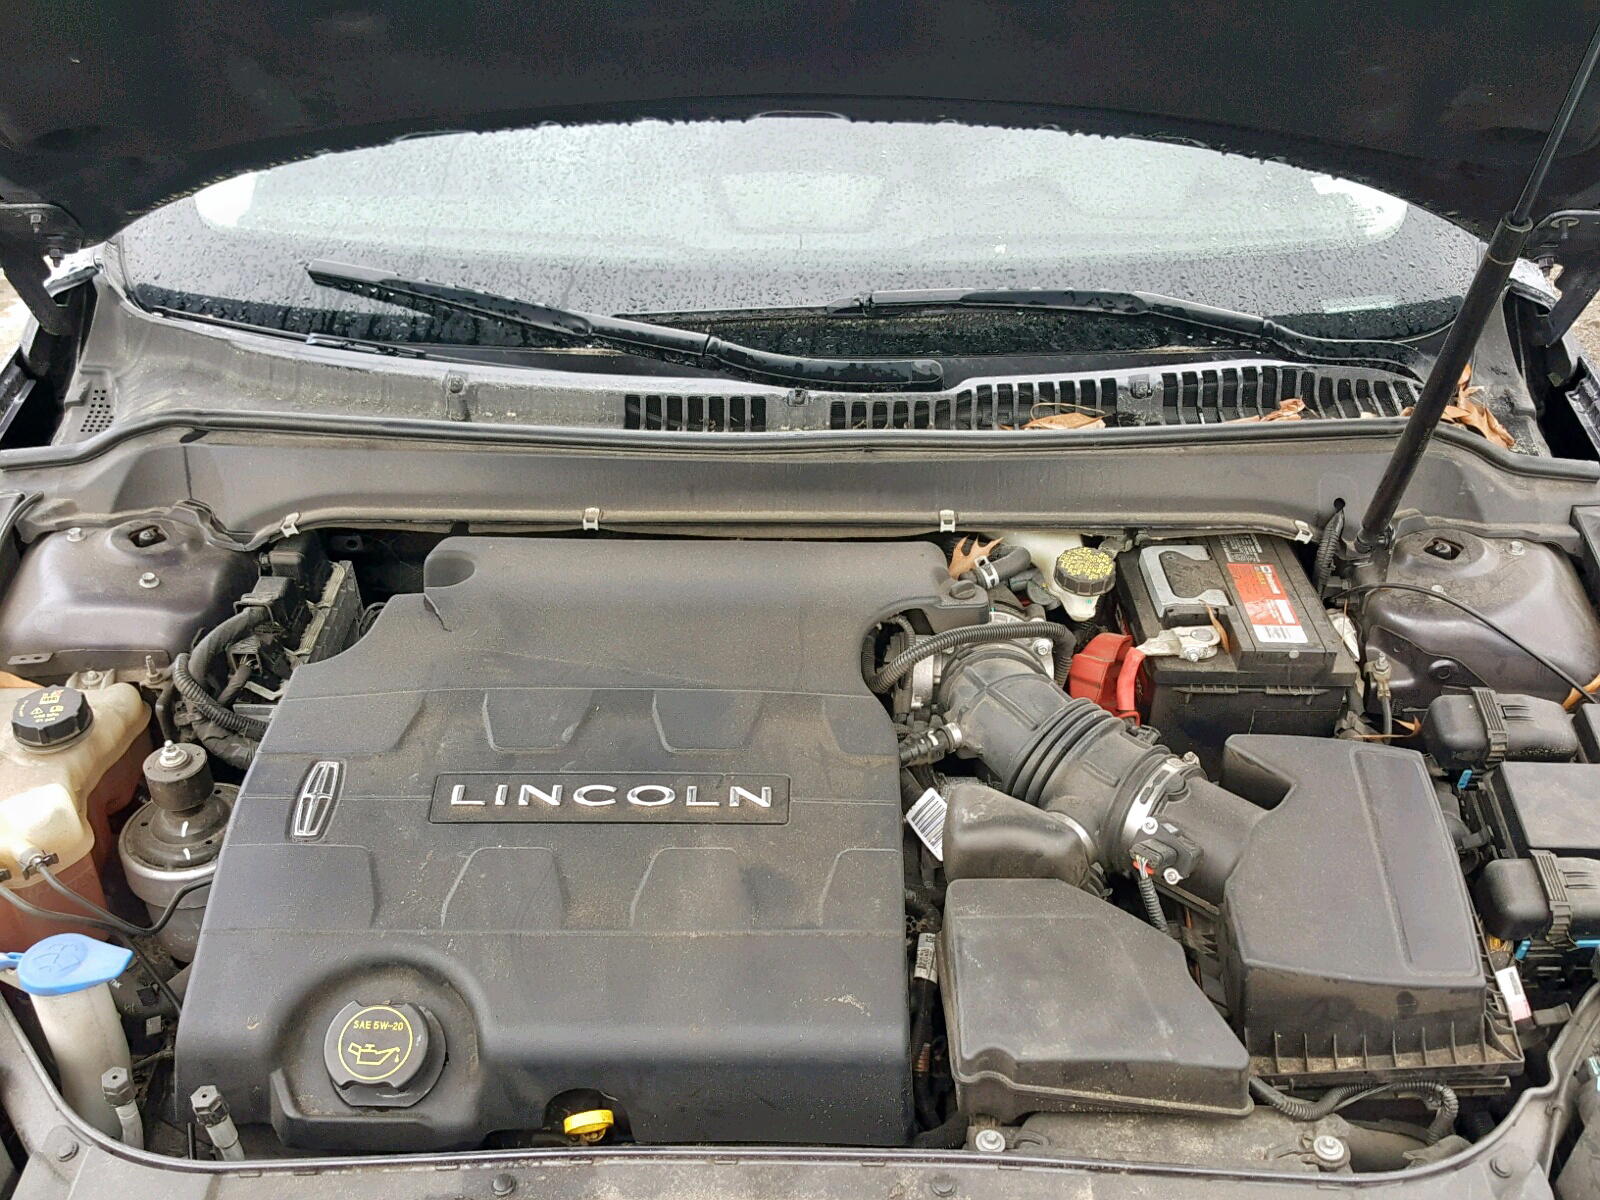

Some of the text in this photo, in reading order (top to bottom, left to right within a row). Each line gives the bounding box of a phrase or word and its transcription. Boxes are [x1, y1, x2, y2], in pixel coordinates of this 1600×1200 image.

[450, 783, 773, 808] LINCOLN
[353, 1020, 404, 1031] SAE 5W-20
